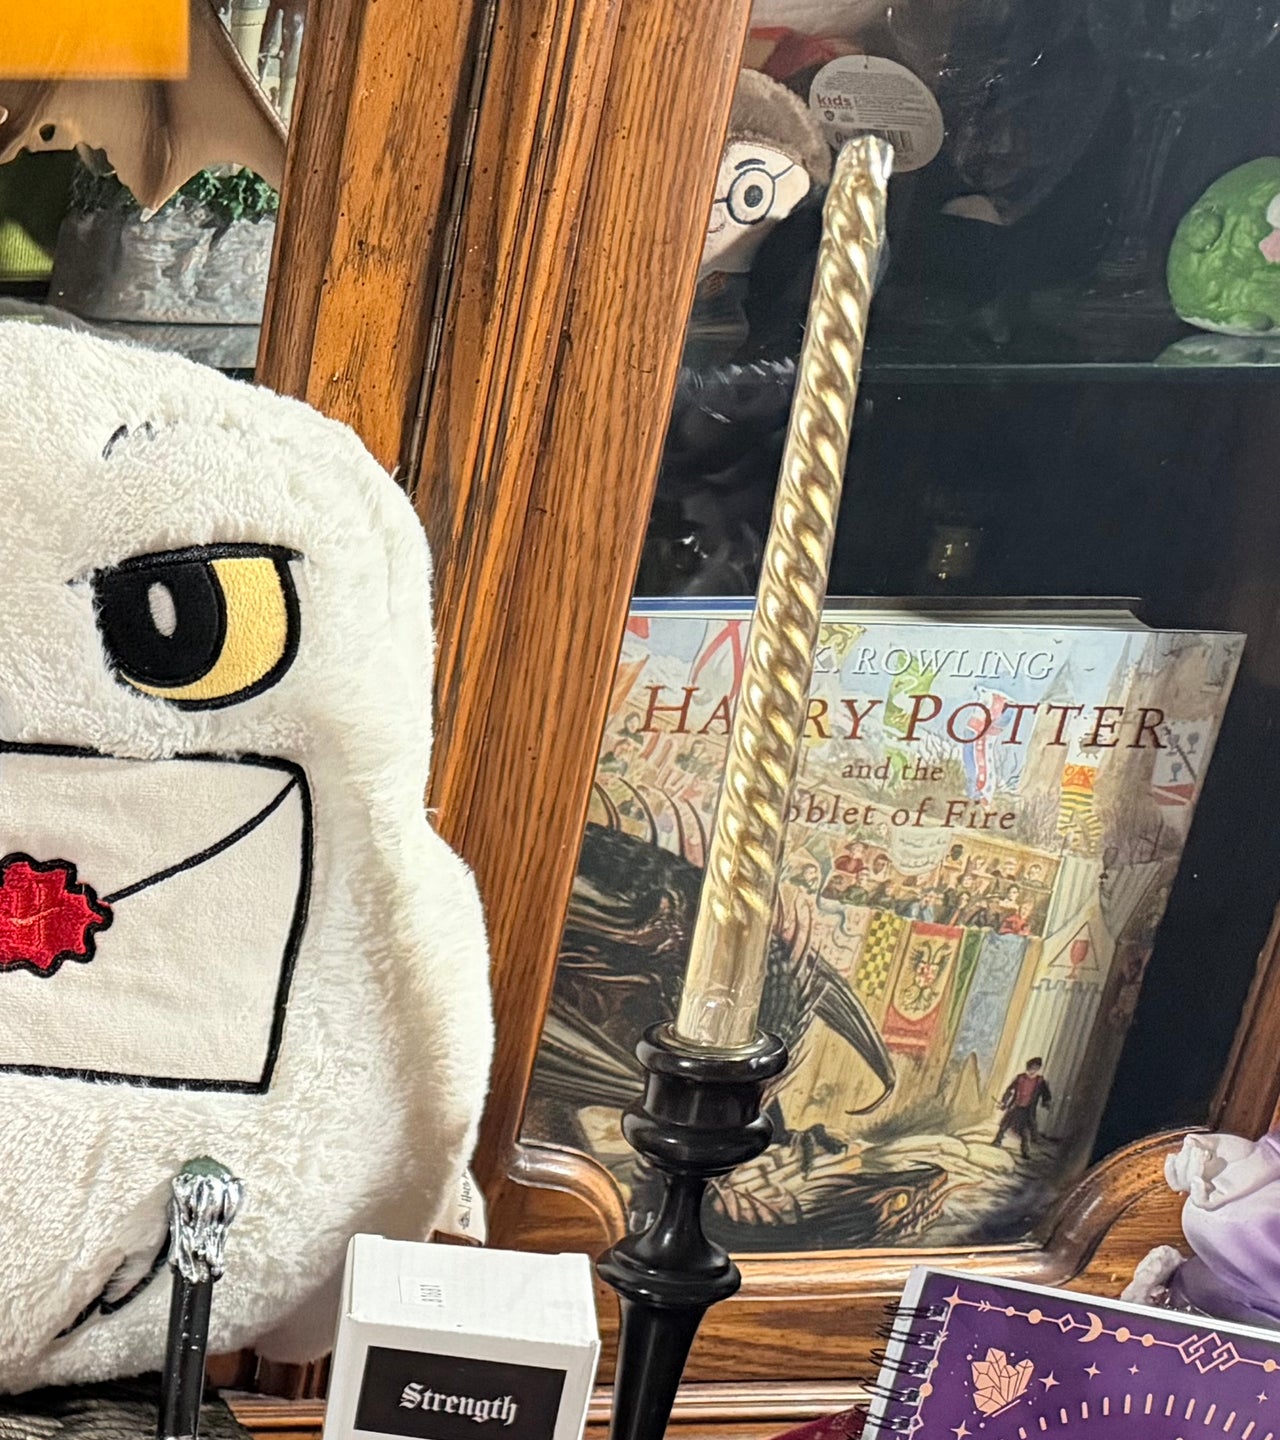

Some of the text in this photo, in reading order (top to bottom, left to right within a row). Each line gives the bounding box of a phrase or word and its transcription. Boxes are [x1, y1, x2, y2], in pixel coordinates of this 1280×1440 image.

[853, 644, 1056, 682] ROWLING
[639, 683, 1173, 751] HARY POTTER
[841, 757, 945, 784] and the
[782, 799, 1019, 832] oblet of Fire
[399, 1381, 519, 1427] Strength
